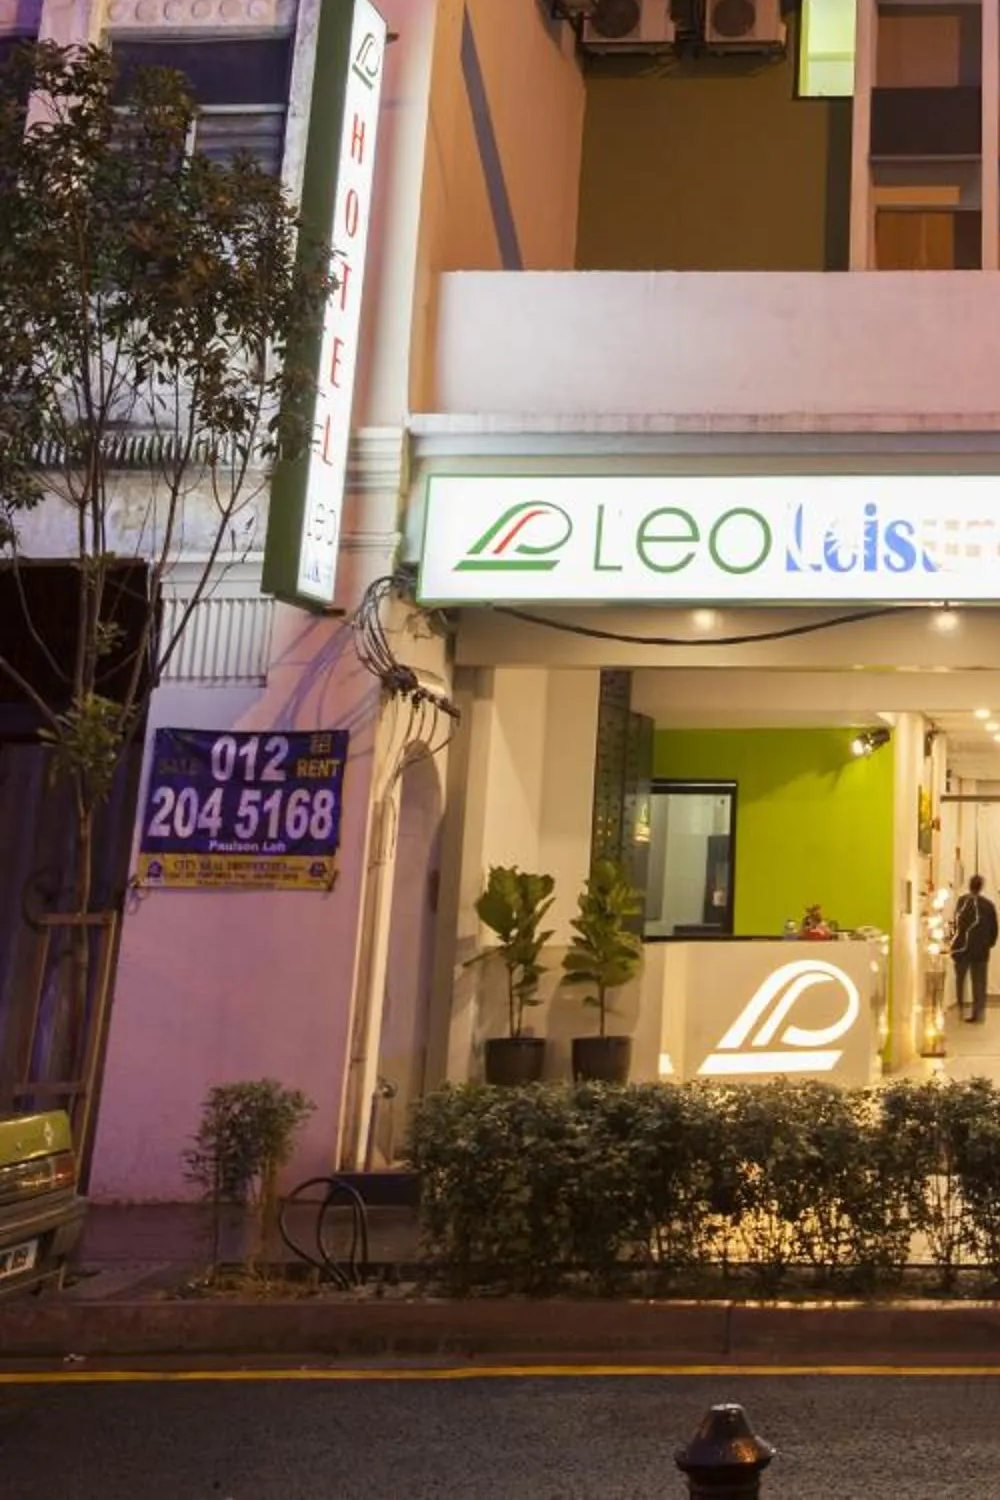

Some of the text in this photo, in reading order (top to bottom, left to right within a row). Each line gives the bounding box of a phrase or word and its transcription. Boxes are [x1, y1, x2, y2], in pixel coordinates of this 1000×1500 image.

[319, 112, 366, 468] HOTEL
[594, 502, 773, 575] Leo
[211, 734, 289, 782] 012
[296, 758, 341, 779] RENT
[147, 785, 336, 841] 204 5168
